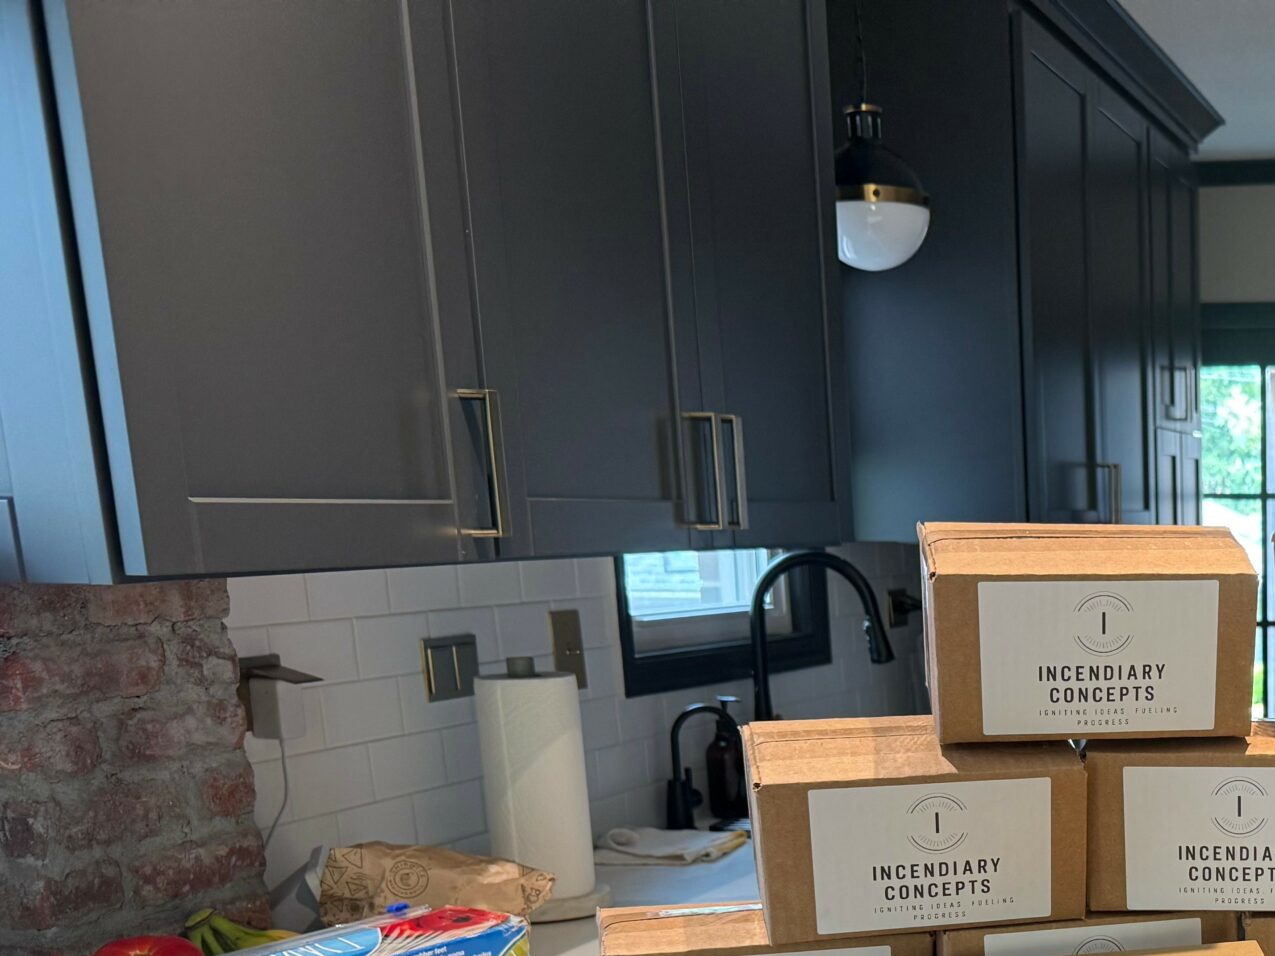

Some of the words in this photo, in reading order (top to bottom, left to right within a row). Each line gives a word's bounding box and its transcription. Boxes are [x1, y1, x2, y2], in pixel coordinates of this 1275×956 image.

[1038, 663, 1166, 682] INCENDIARY
[1049, 685, 1155, 703] CONCEPTS
[872, 857, 1001, 882] INCENDIARY
[884, 878, 991, 901] CONCEPTS
